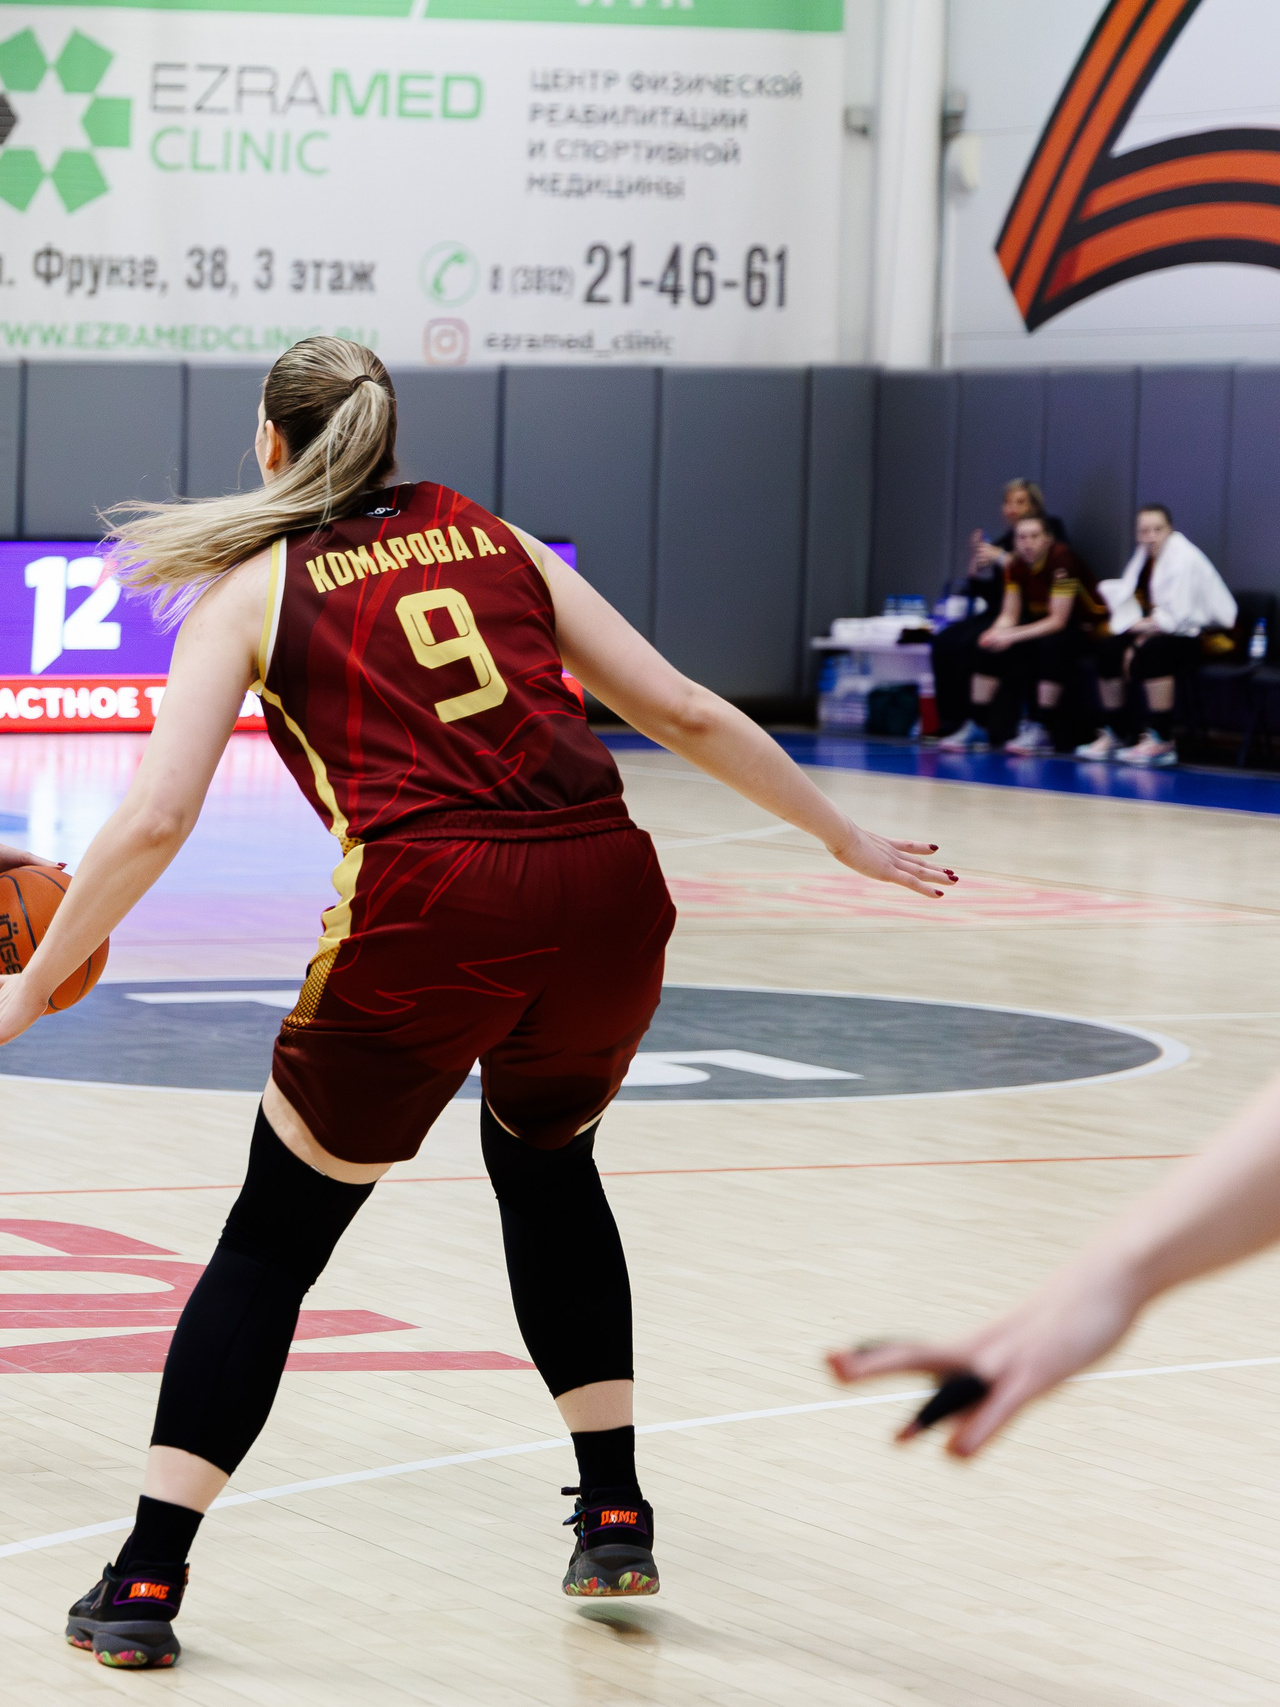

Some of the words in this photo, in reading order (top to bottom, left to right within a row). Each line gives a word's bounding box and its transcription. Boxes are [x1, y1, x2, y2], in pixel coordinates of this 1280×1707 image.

[150, 63, 485, 119] EZRAMED
[530, 67, 620, 92] ЦЕНТР
[629, 70, 803, 98] ФИЗИЧЕСКОЙ
[529, 102, 748, 131] РЕАБИЛИТАЦИИ
[150, 126, 329, 174] CLINIC
[529, 140, 545, 159] И
[555, 138, 741, 165] СПОРТИВНОЙ
[527, 173, 685, 198] МЕДИЦИНЫ
[32, 243, 169, 295] Фрунзе,
[185, 247, 239, 296] 38,
[254, 248, 274, 290] 3
[290, 259, 376, 292] этаж
[584, 243, 788, 308] 21-46-61
[306, 526, 474, 593] КОМАРОВА
[25, 555, 122, 674] 12
[395, 588, 508, 723] 9
